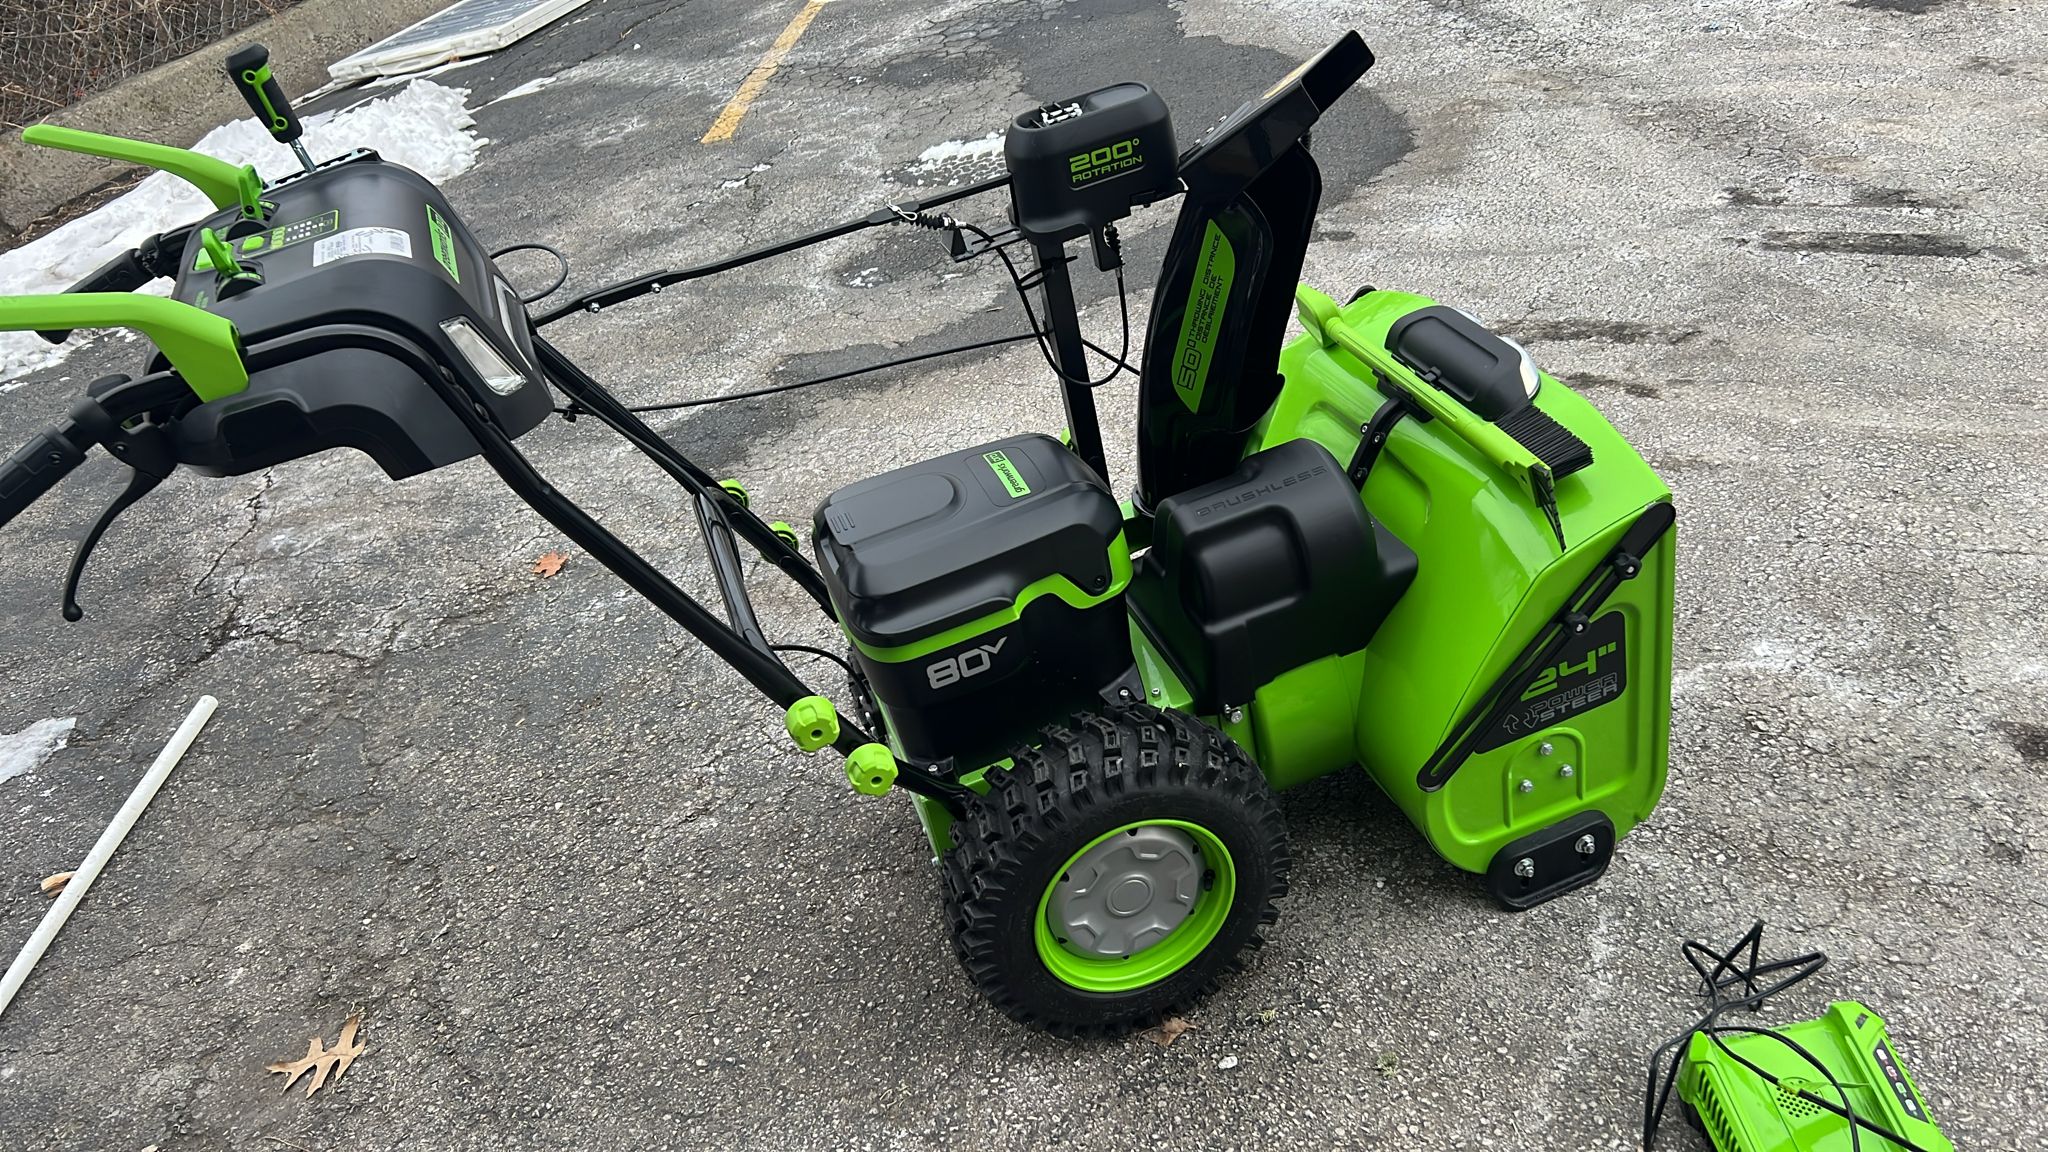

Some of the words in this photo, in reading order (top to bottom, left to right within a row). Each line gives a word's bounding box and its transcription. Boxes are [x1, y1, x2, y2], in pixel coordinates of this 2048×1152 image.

[1069, 138, 1140, 173] 200°
[1072, 154, 1143, 183] ROTATION
[1189, 288, 1207, 337] THROWING
[1203, 234, 1221, 285] DISTANCE
[1195, 293, 1213, 340] DISTANCE
[1209, 274, 1218, 289] DE
[998, 463, 1026, 493] greenworks
[1195, 465, 1328, 519] BRUSHLESS
[926, 636, 1008, 690] 80V
[1520, 641, 1617, 702] 24"
[1530, 672, 1618, 716] POWER
[1540, 683, 1618, 722] STEER
